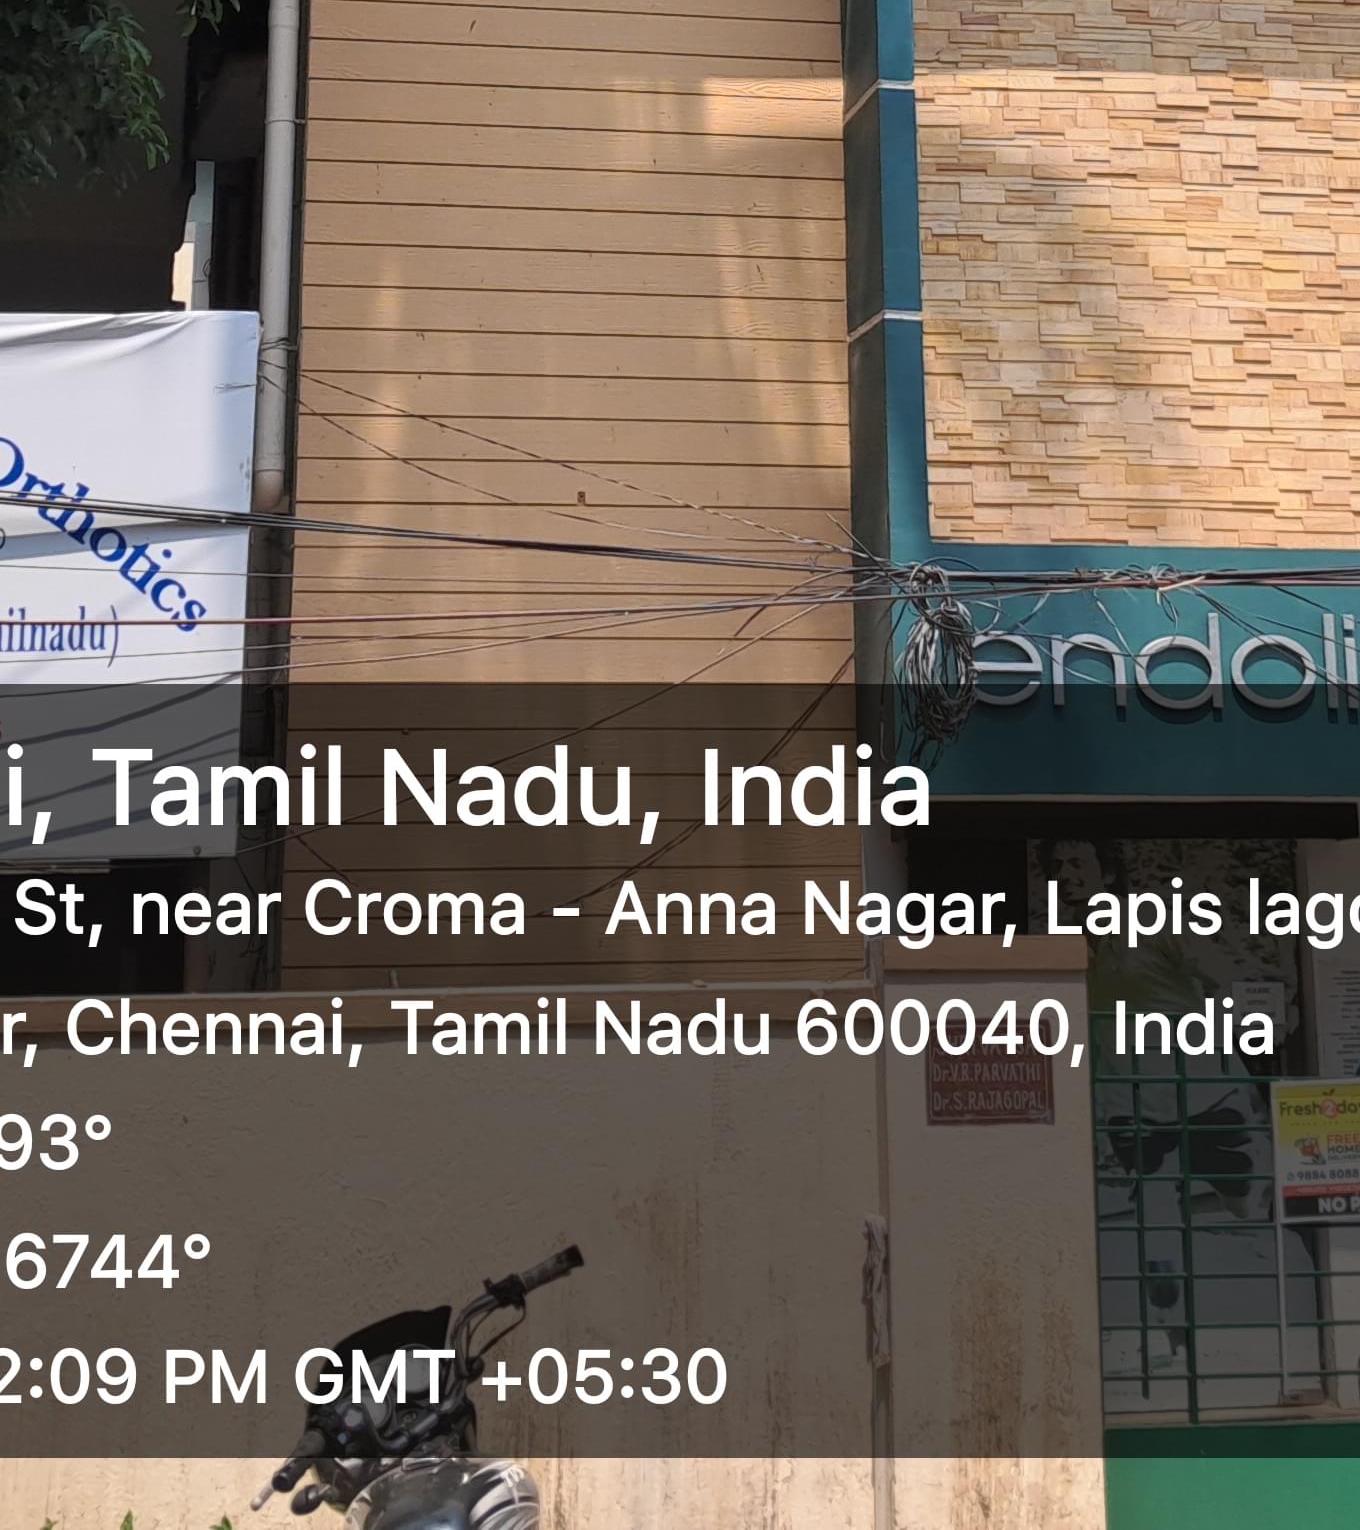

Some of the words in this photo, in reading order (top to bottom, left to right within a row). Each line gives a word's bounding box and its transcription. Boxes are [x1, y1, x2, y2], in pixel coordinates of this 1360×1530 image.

[1328, 1133, 1360, 1144] FREE
[1328, 1144, 1360, 1154] HOME
[1317, 1197, 1346, 1213] NO
